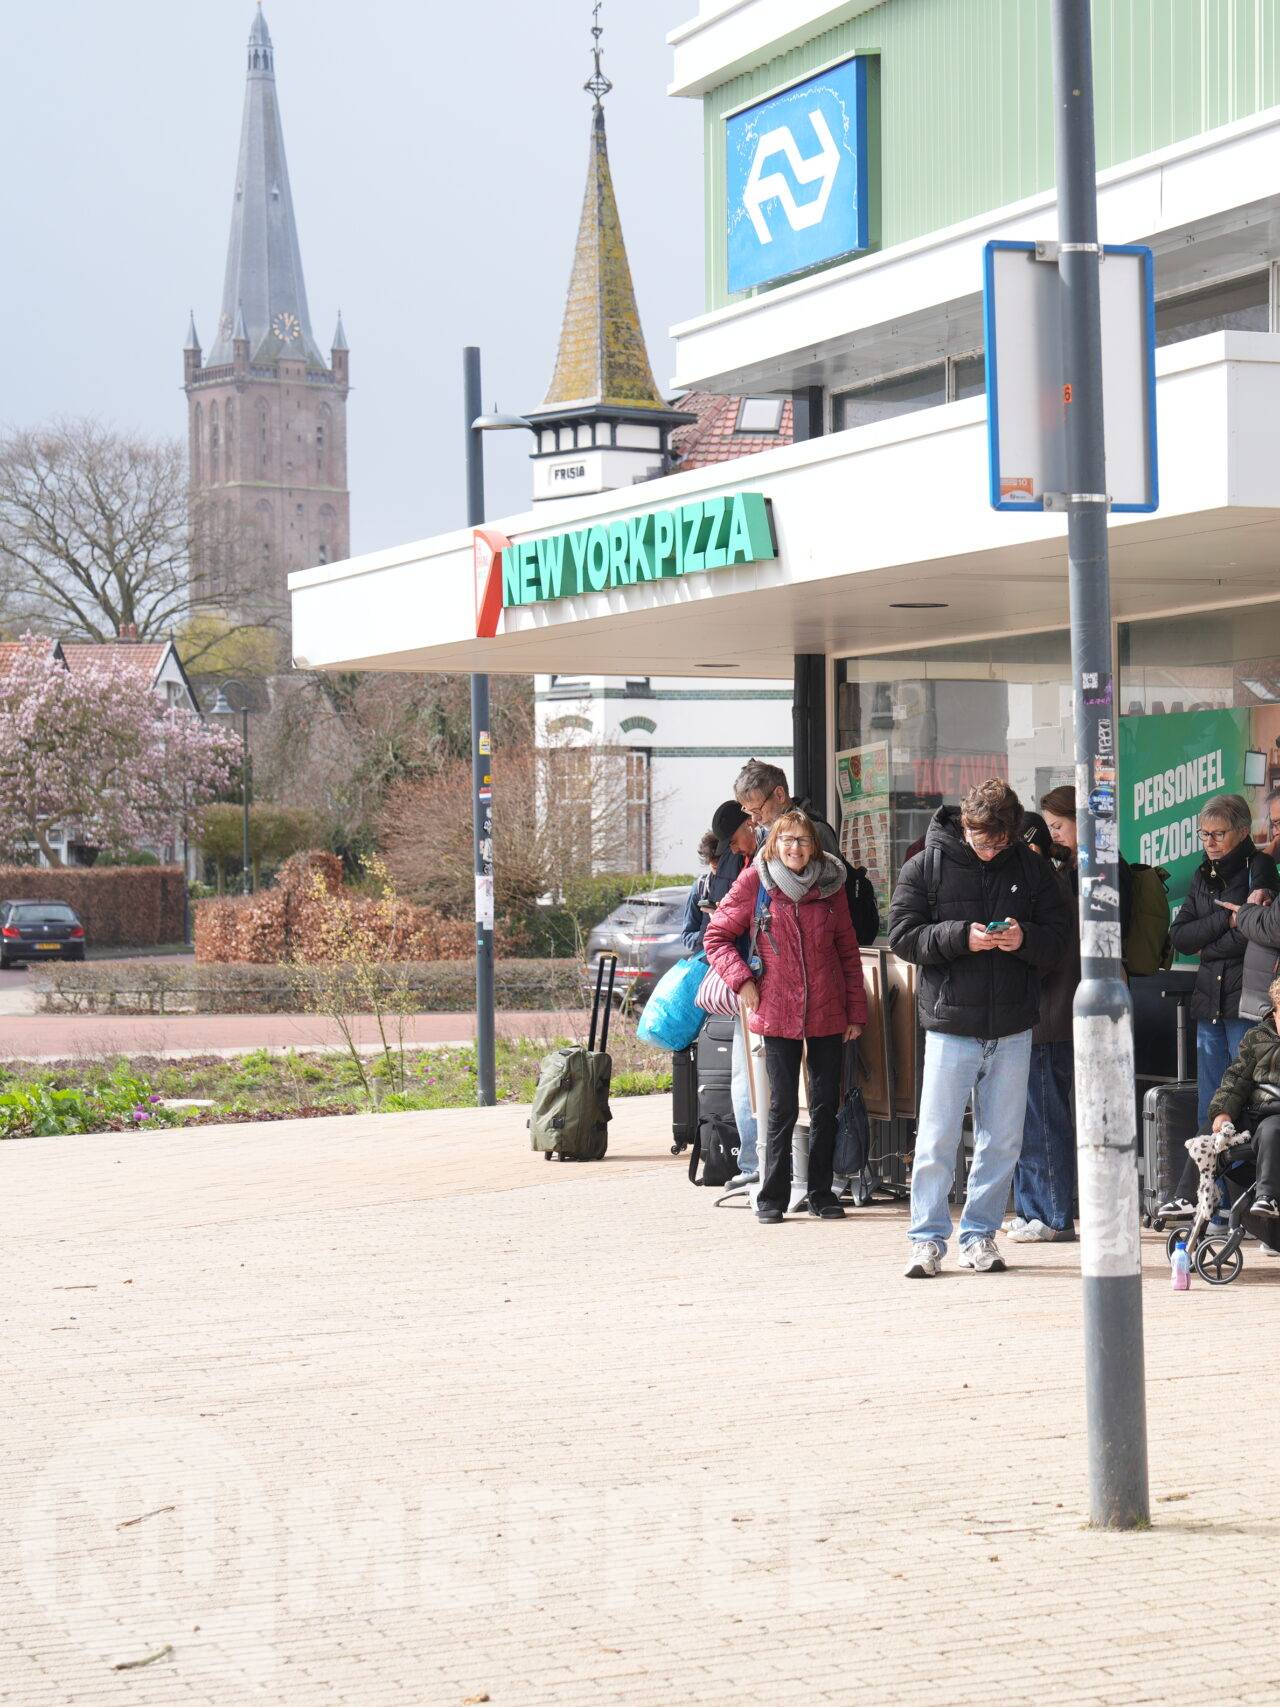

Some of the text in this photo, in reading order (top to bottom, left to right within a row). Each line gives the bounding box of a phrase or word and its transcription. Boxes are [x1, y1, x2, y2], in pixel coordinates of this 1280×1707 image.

[555, 466, 585, 480] FRISIA
[502, 533, 566, 608] NEW
[570, 515, 653, 592] YORK
[654, 492, 756, 579] PIZZA
[912, 757, 956, 797] TAKE
[1134, 749, 1225, 821] PERSONEEL
[1140, 813, 1201, 869] GEZOCH
